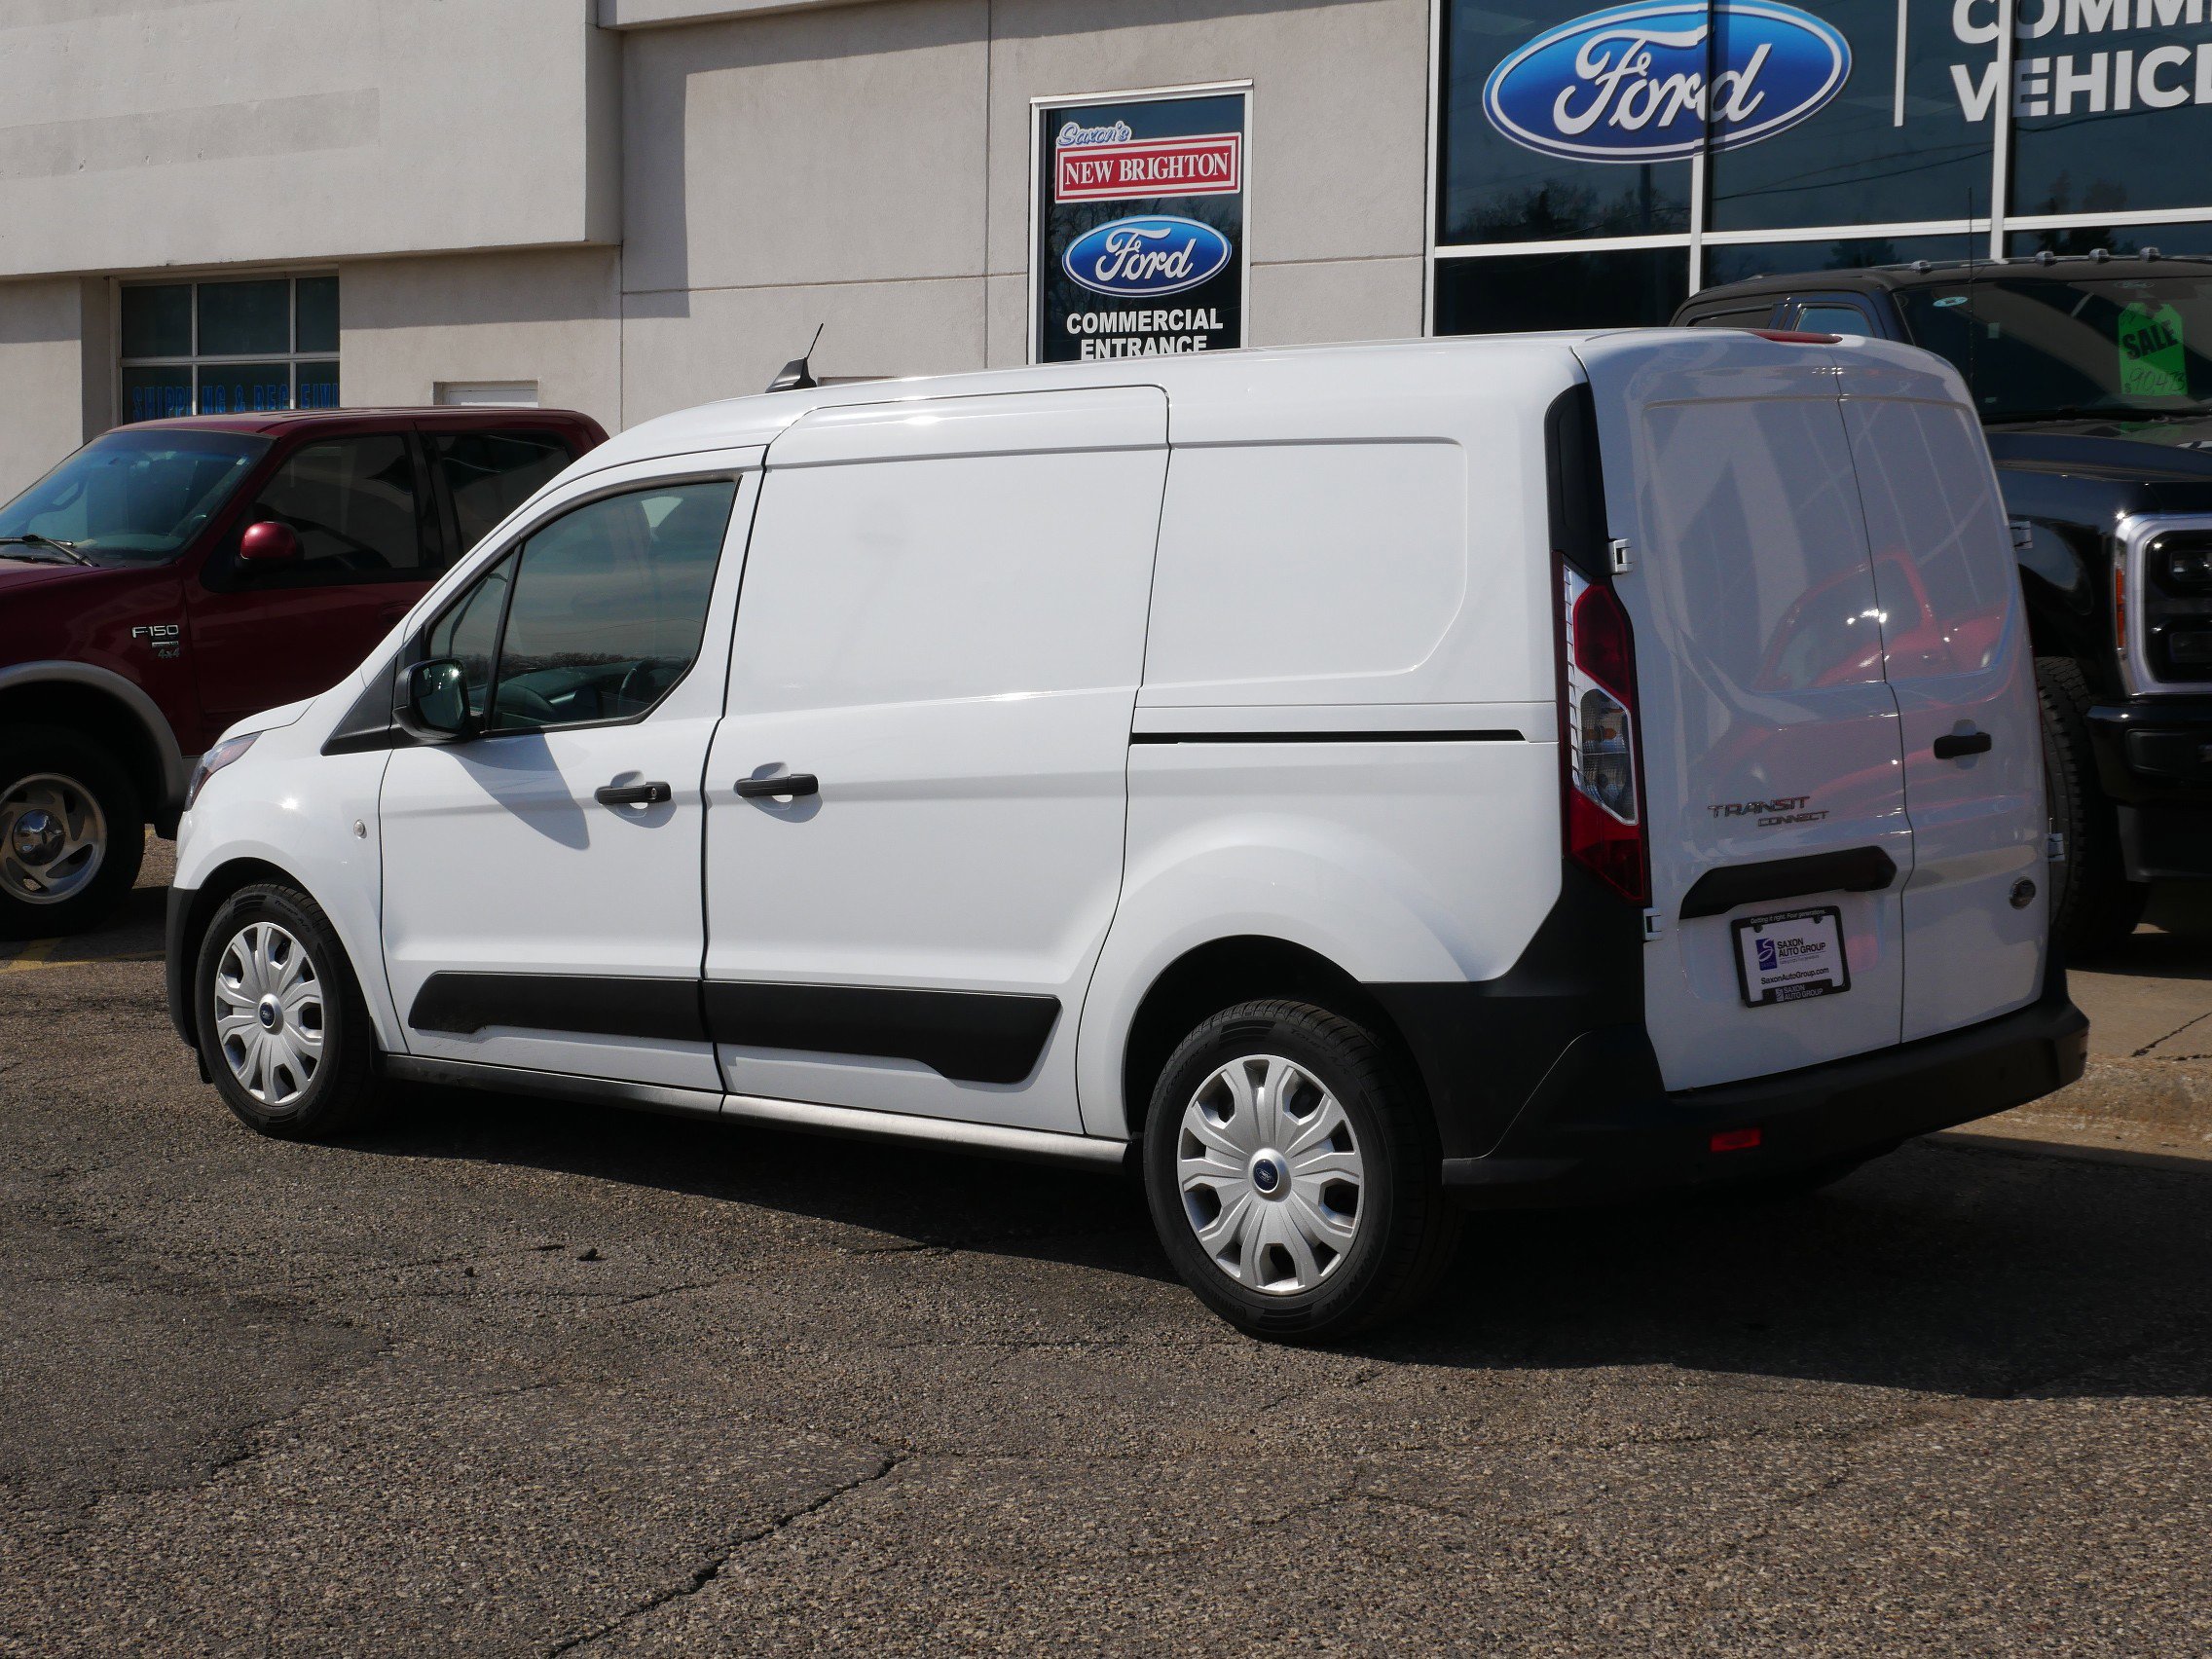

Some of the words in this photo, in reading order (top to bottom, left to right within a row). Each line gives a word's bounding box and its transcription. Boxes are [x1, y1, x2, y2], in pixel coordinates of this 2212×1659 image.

[1554, 24, 1774, 135] Ford
[1057, 122, 1130, 146] Saxon's
[1065, 160, 1115, 185] NEW
[1119, 152, 1229, 182] BRIGHTON
[1095, 227, 1197, 281] Ford
[1066, 308, 1224, 335] COMMERCIAL
[1081, 336, 1207, 360] ENTRANCE
[2121, 319, 2179, 360] SALE
[234, 384, 245, 413] &
[131, 624, 179, 639] F-150
[1708, 795, 1811, 818] TRANSIT
[1758, 810, 1829, 828] CONNECT
[1777, 938, 1804, 949] SAXON
[1778, 947, 1799, 958] AUTO
[1800, 942, 1826, 954] GROUP
[1760, 968, 1829, 984] SaxonAutoGroup.com
[1783, 984, 1806, 994] SAXON
[1784, 991, 1801, 1001] AUTO
[1802, 988, 1824, 999] GROUP
